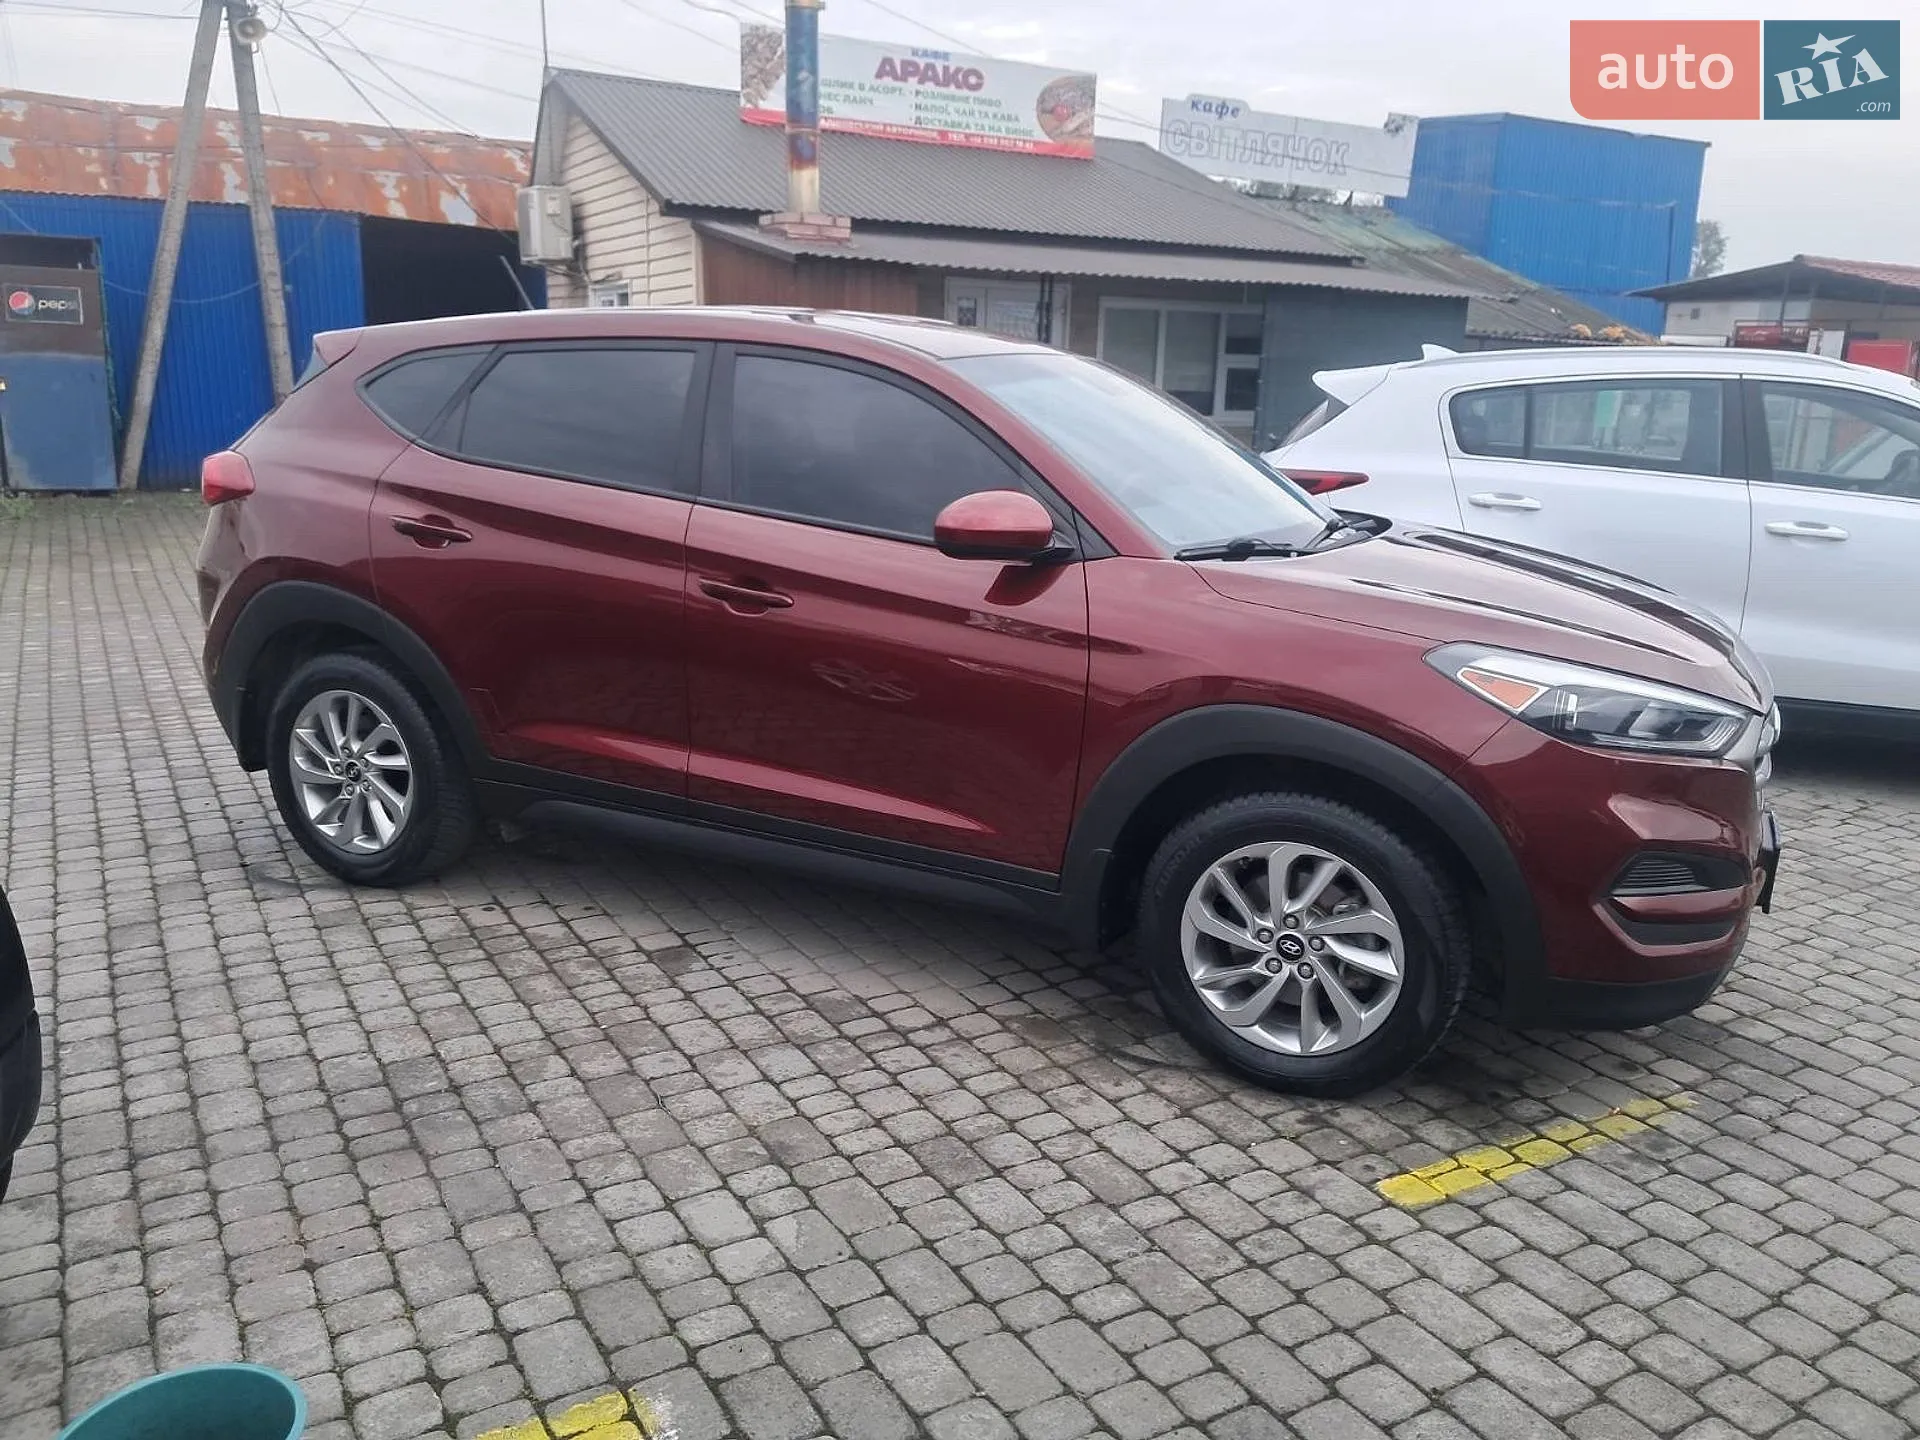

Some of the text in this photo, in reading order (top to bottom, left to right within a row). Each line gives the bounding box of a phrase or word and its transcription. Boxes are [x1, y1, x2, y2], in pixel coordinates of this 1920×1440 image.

[875, 57, 985, 91] АРАКС
[1190, 98, 1241, 120] кафе
[1166, 118, 1351, 176] СВІТЛЯЧОК
